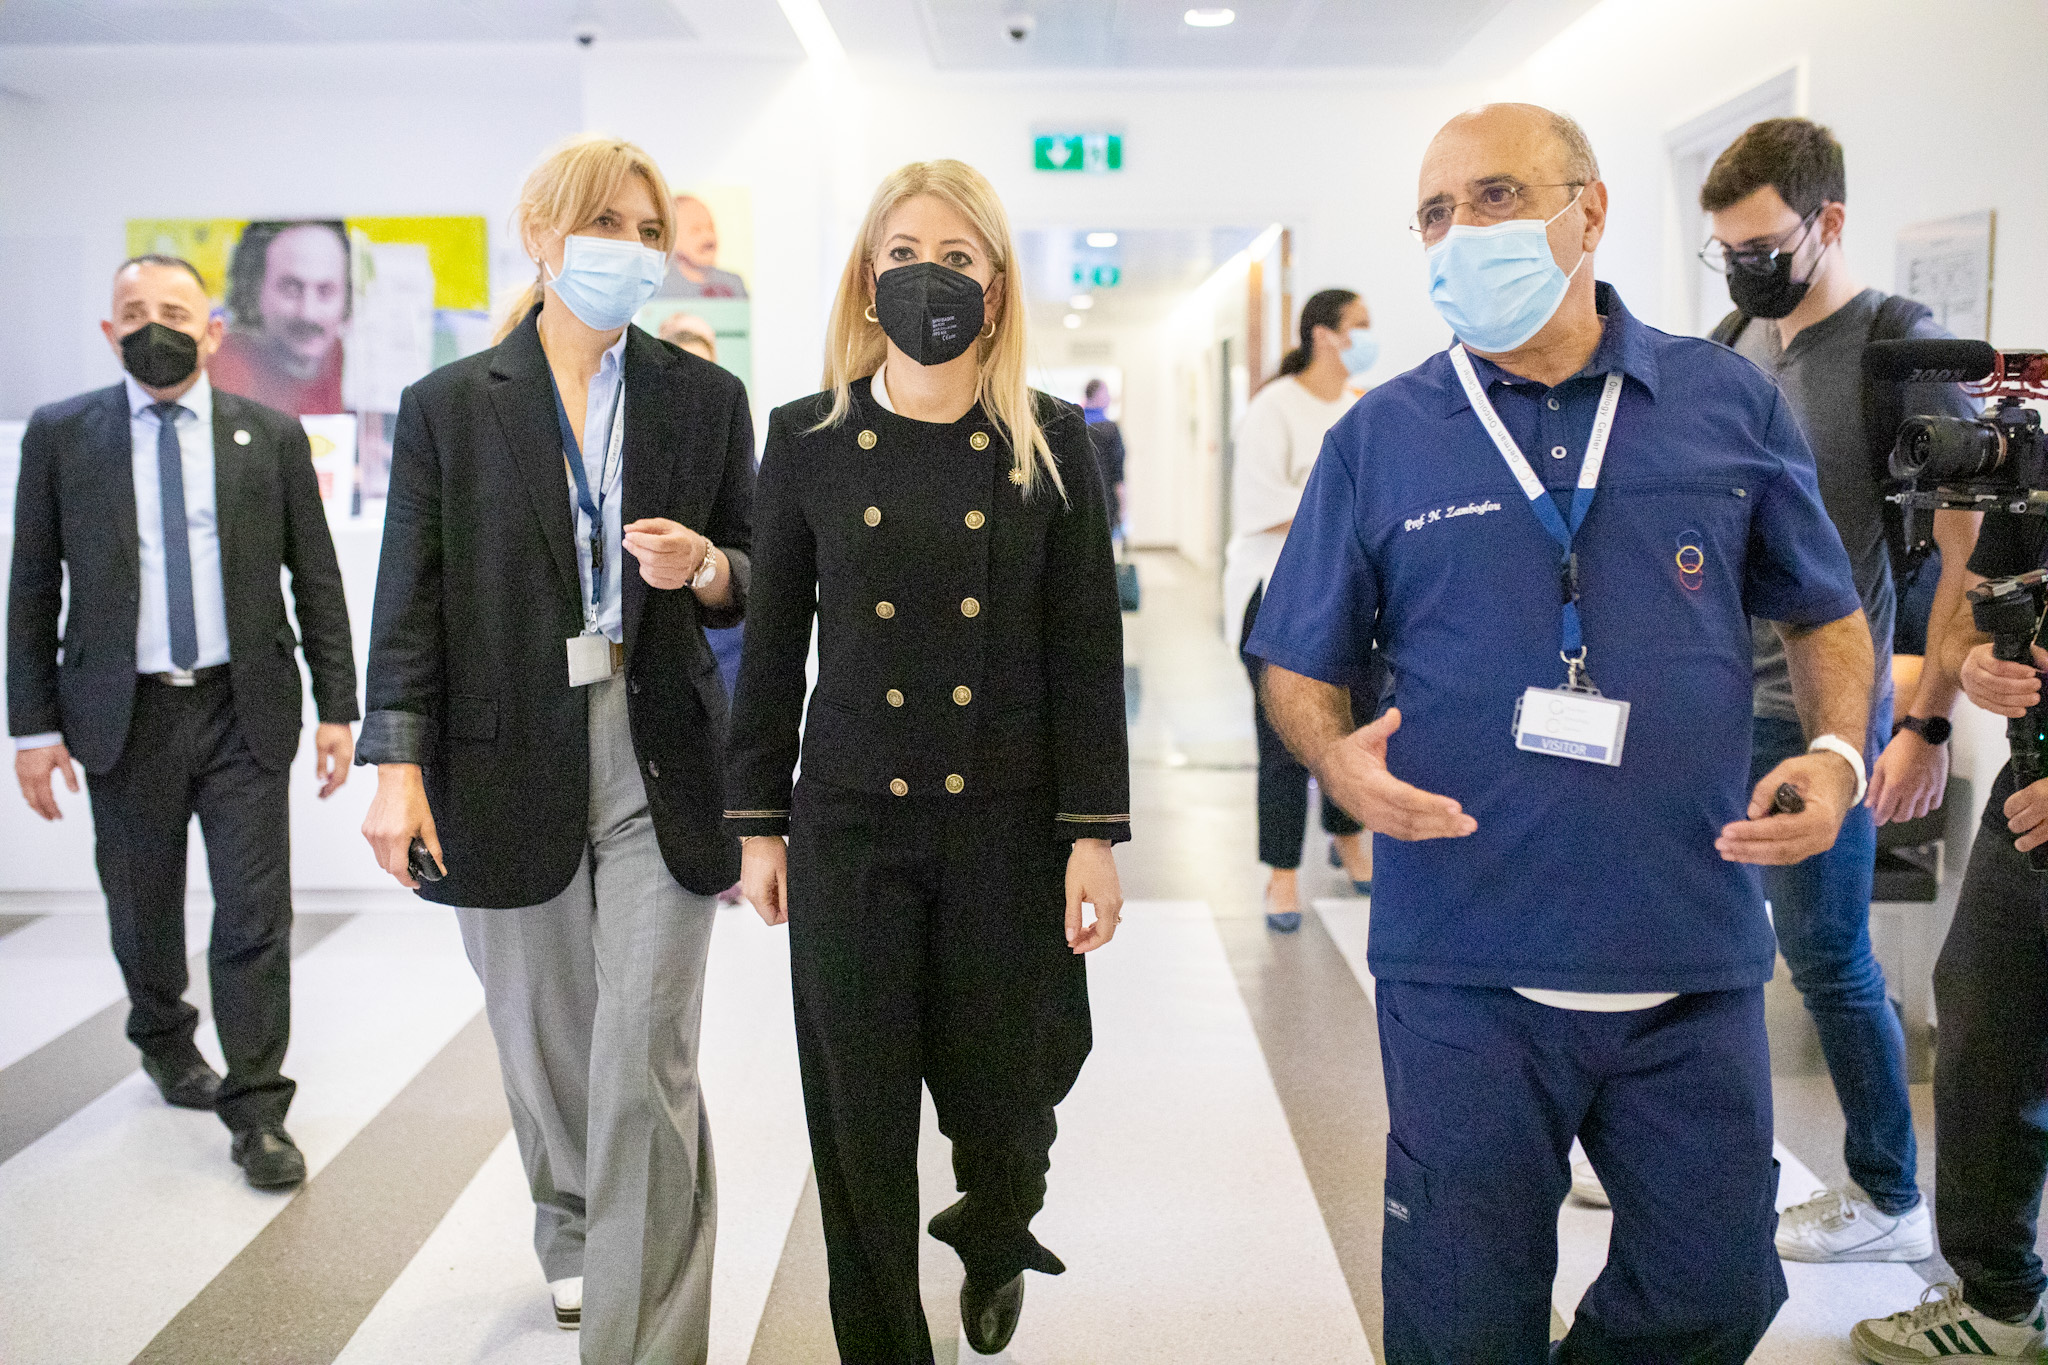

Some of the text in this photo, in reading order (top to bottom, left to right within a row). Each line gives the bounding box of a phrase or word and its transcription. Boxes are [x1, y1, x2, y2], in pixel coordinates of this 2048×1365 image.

[1463, 368, 1520, 463] German Oncology Center
[1592, 381, 1618, 450] Oncology Center
[609, 433, 620, 463] German
[1445, 500, 1502, 518] Zamboglou
[1541, 738, 1587, 756] VISITOR
